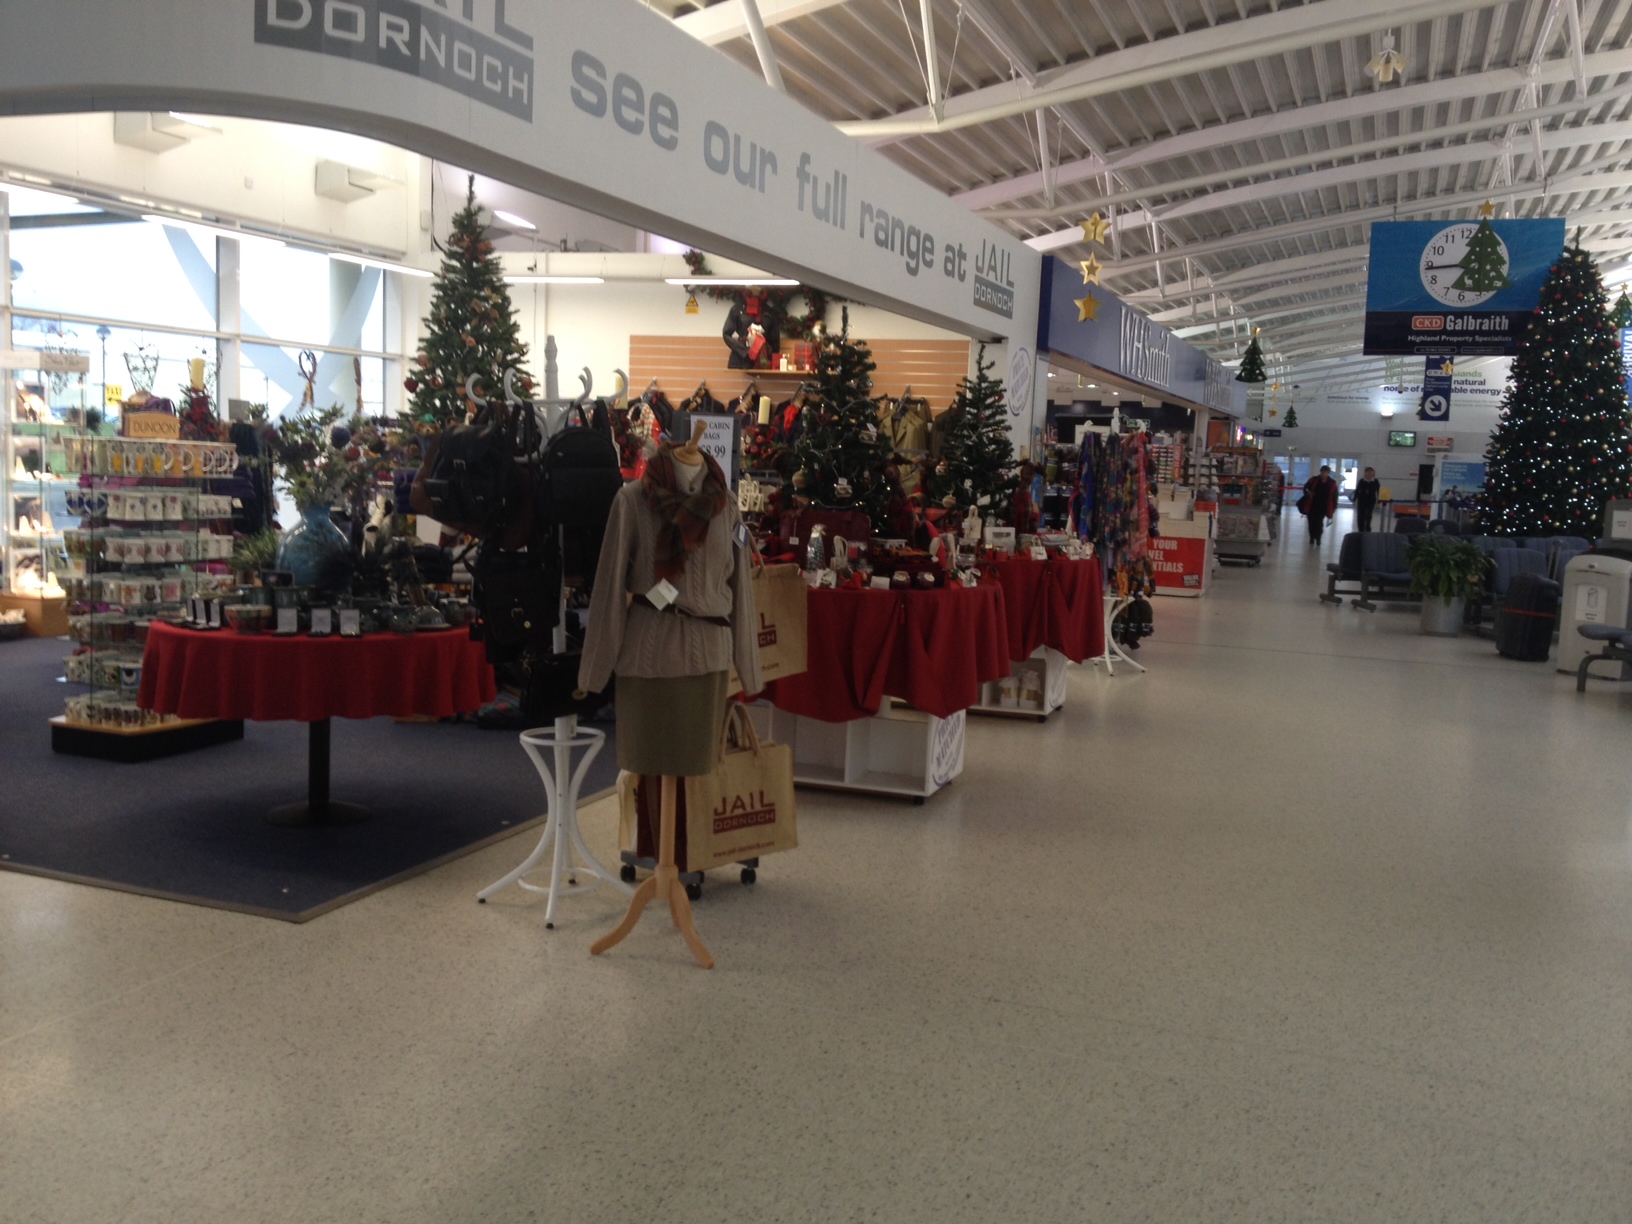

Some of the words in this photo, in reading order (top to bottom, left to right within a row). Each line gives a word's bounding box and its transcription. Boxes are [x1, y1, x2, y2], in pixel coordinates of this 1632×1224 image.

[267, 0, 529, 106] DORNOCH
[570, 49, 679, 151] see
[703, 120, 778, 193] our
[796, 152, 848, 230] full
[859, 200, 935, 277] range
[943, 243, 967, 283] at
[975, 238, 1015, 289] JAIL
[1445, 233, 1455, 243] 11
[1461, 229, 1472, 240] 12
[1433, 246, 1445, 256] 10
[1427, 260, 1434, 268] 9
[1430, 275, 1438, 285] 8
[1443, 286, 1450, 296] 7
[1458, 291, 1465, 301] 6
[974, 283, 1013, 313] DORNOCH
[1416, 318, 1440, 327] CKD
[1446, 315, 1509, 331] Galbraith
[1408, 335, 1439, 343] Highland
[1441, 335, 1473, 343] Property
[1120, 305, 1170, 388] WHSmith
[106, 386, 122, 396] TAXI
[1469, 388, 1502, 396] energy
[133, 421, 176, 435] DUNOON
[709, 421, 730, 430] CABIN
[703, 432, 721, 440] BAGS
[1153, 539, 1178, 550] YOUR
[1148, 550, 1164, 561] VEL
[1152, 561, 1184, 573] NTIALS
[713, 790, 775, 816] JAIL
[714, 812, 775, 831] DORNOCH
